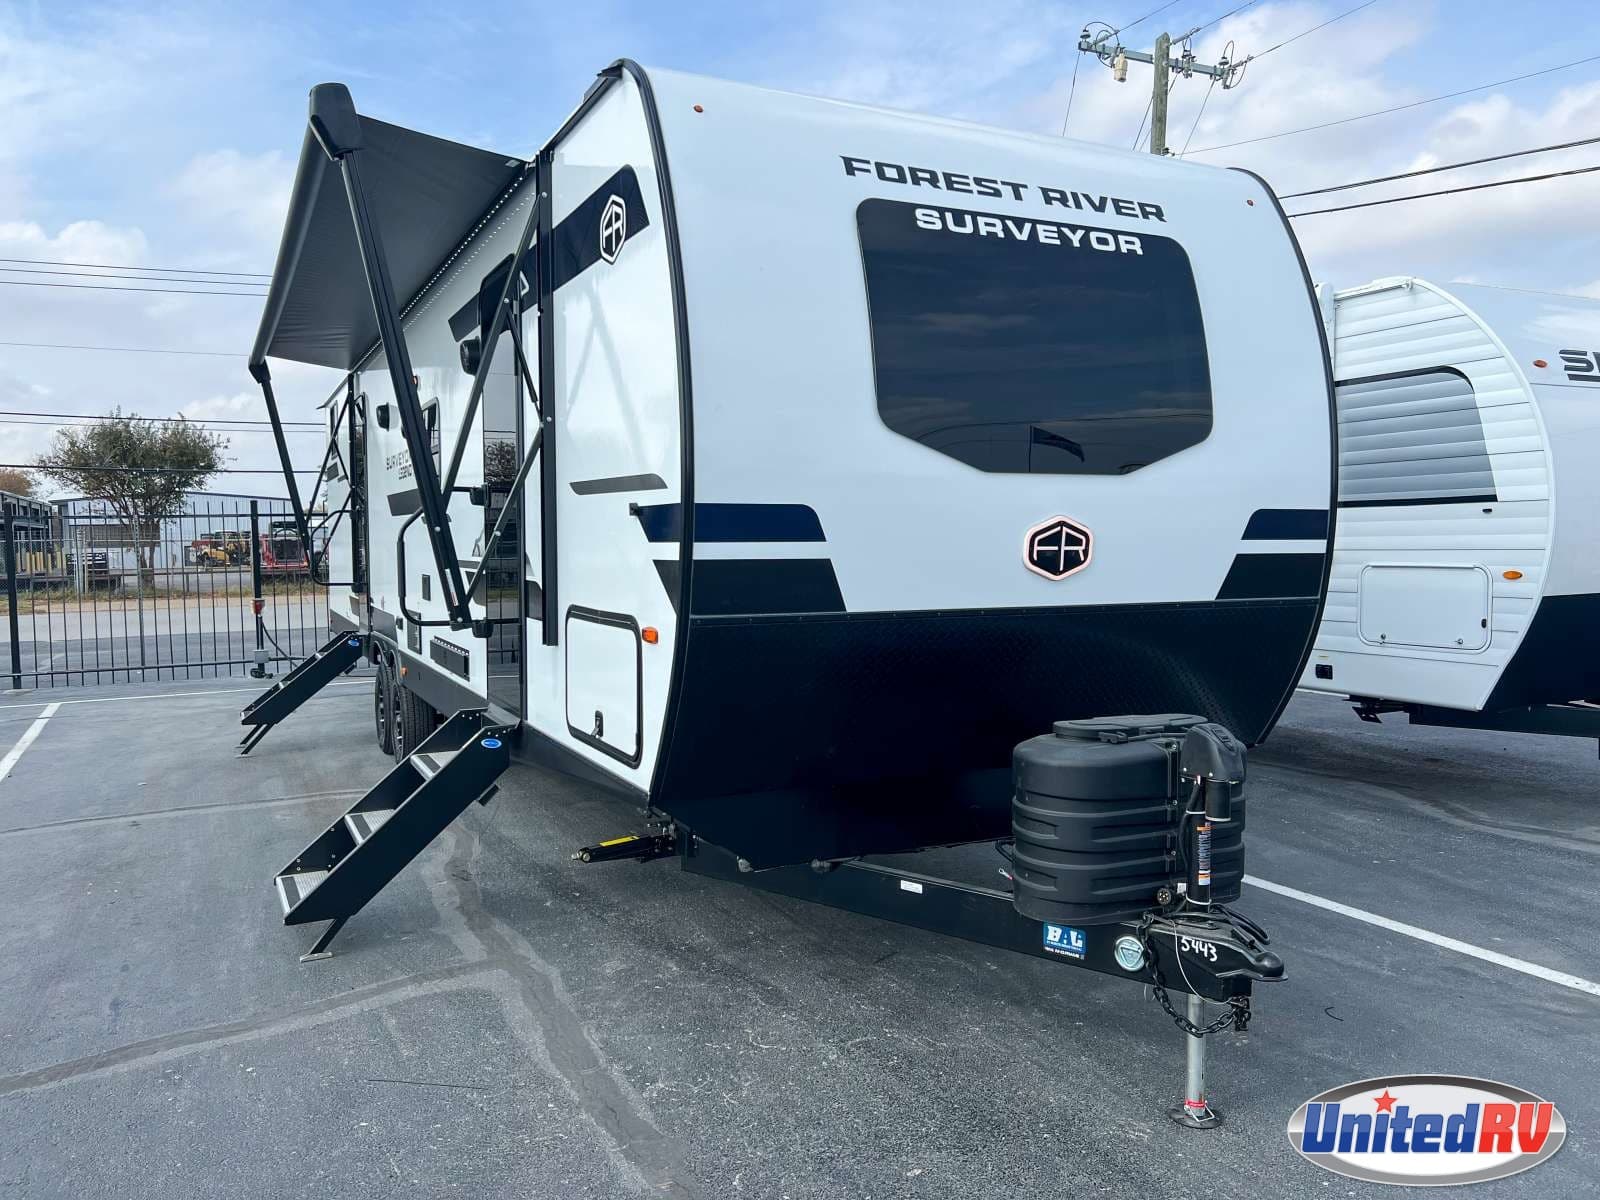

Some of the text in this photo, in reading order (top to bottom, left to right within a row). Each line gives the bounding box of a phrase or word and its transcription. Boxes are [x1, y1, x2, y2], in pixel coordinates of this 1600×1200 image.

[840, 155, 1168, 223] FOREST RIVER
[914, 207, 1144, 256] SURVEYOR
[385, 449, 410, 471] SURVEYO
[1181, 935, 1218, 962] 5443
